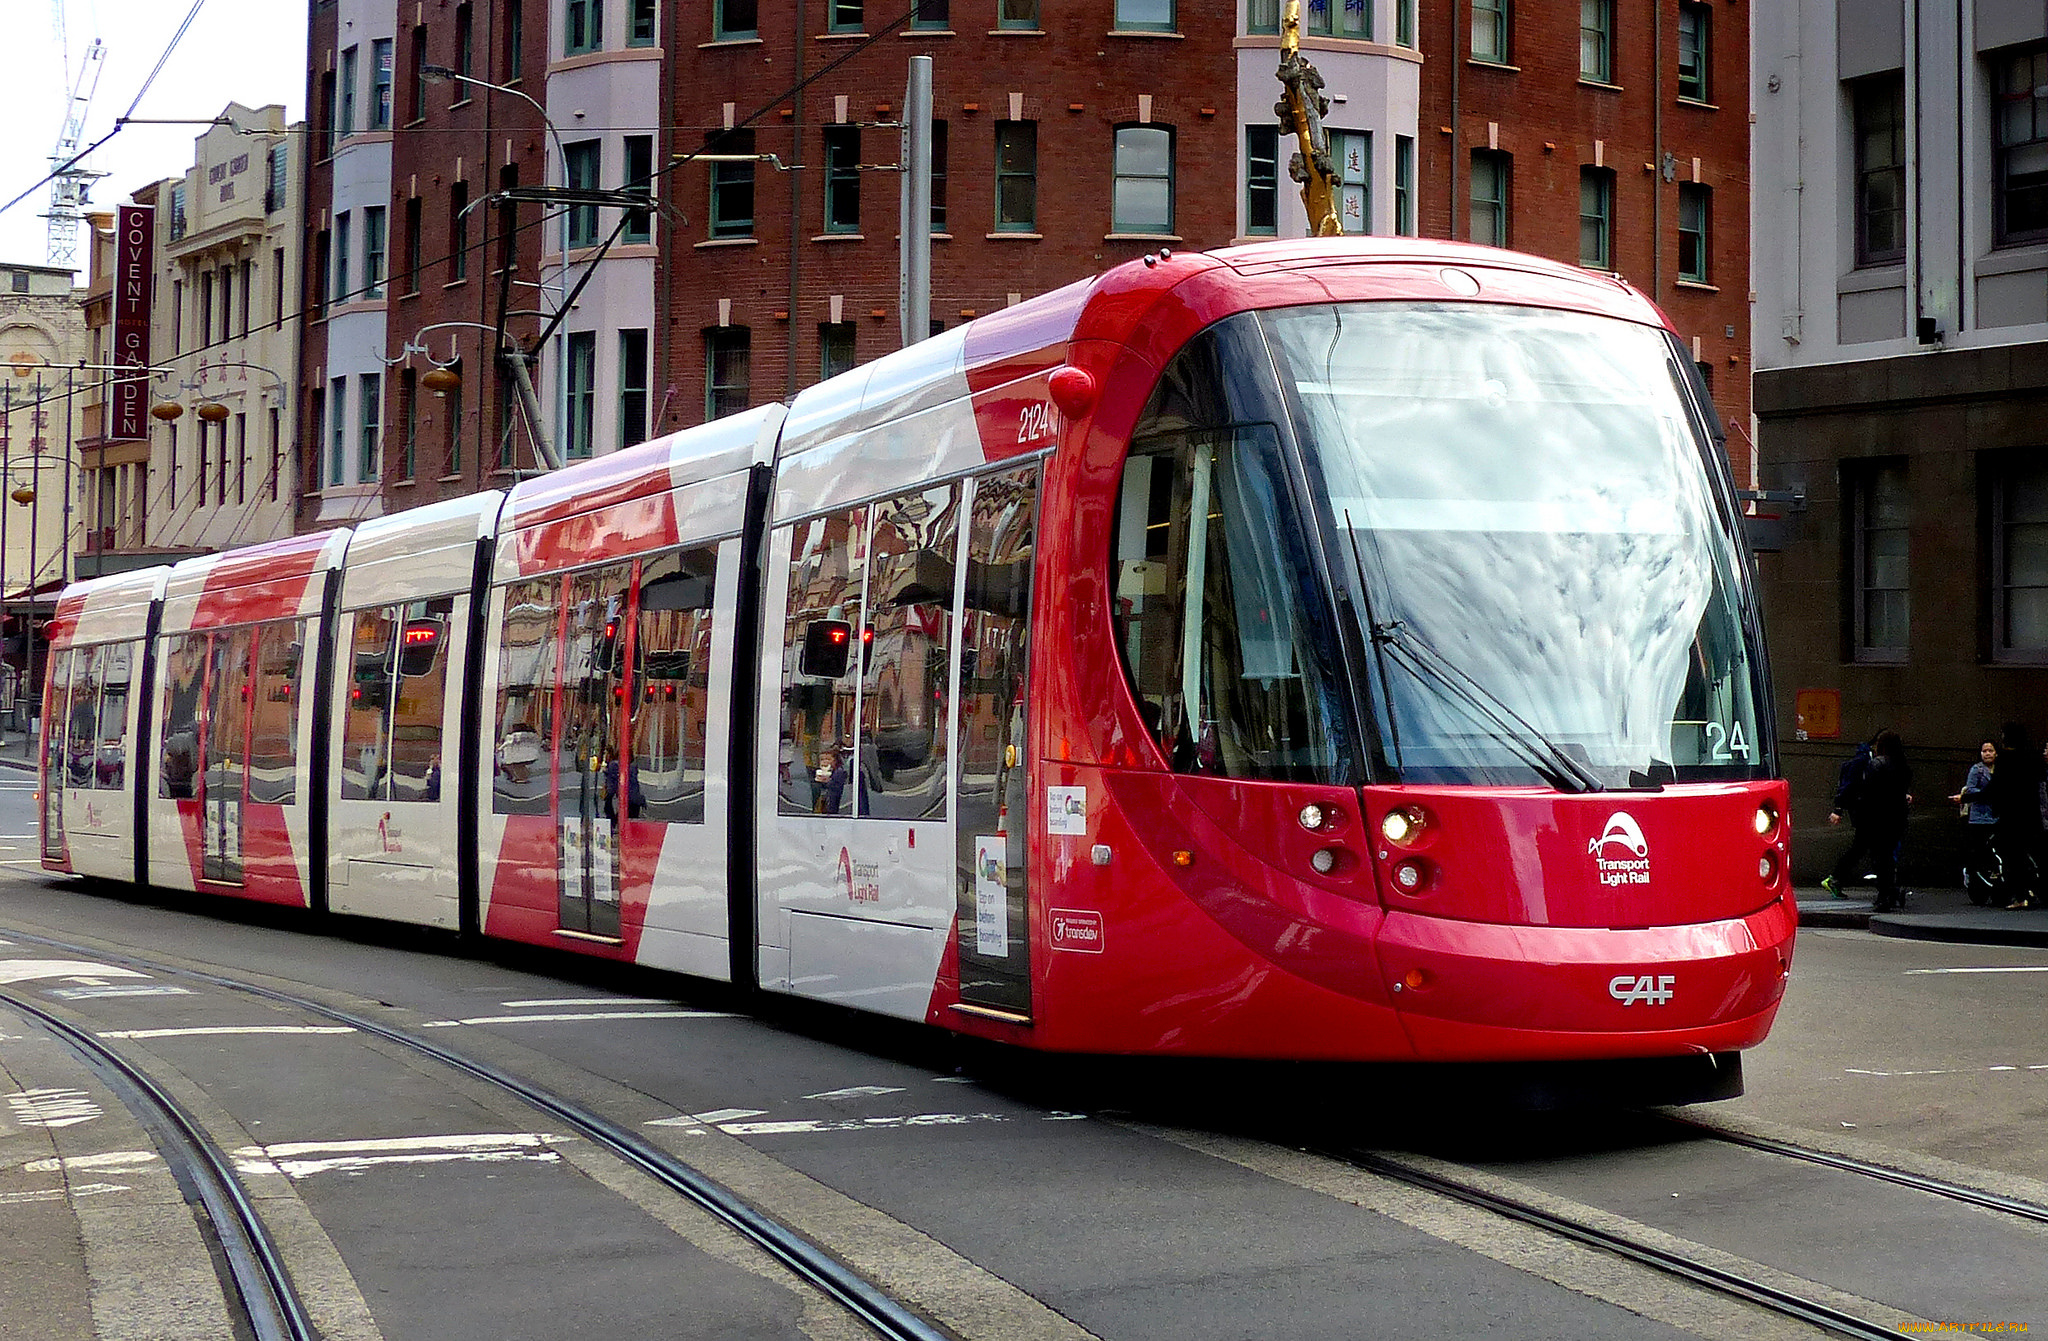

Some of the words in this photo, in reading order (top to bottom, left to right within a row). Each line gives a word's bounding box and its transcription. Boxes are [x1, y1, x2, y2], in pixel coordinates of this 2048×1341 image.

[128, 212, 144, 313] COVENT
[1018, 401, 1049, 444] 2124
[1706, 721, 1749, 760] 24
[852, 859, 879, 880] Transport
[1597, 857, 1650, 873] Transport
[1600, 871, 1628, 887] Light
[1630, 871, 1650, 884] Rail
[854, 883, 868, 904] Light
[1065, 925, 1098, 940] transdev
[1609, 976, 1676, 1006] CAF
